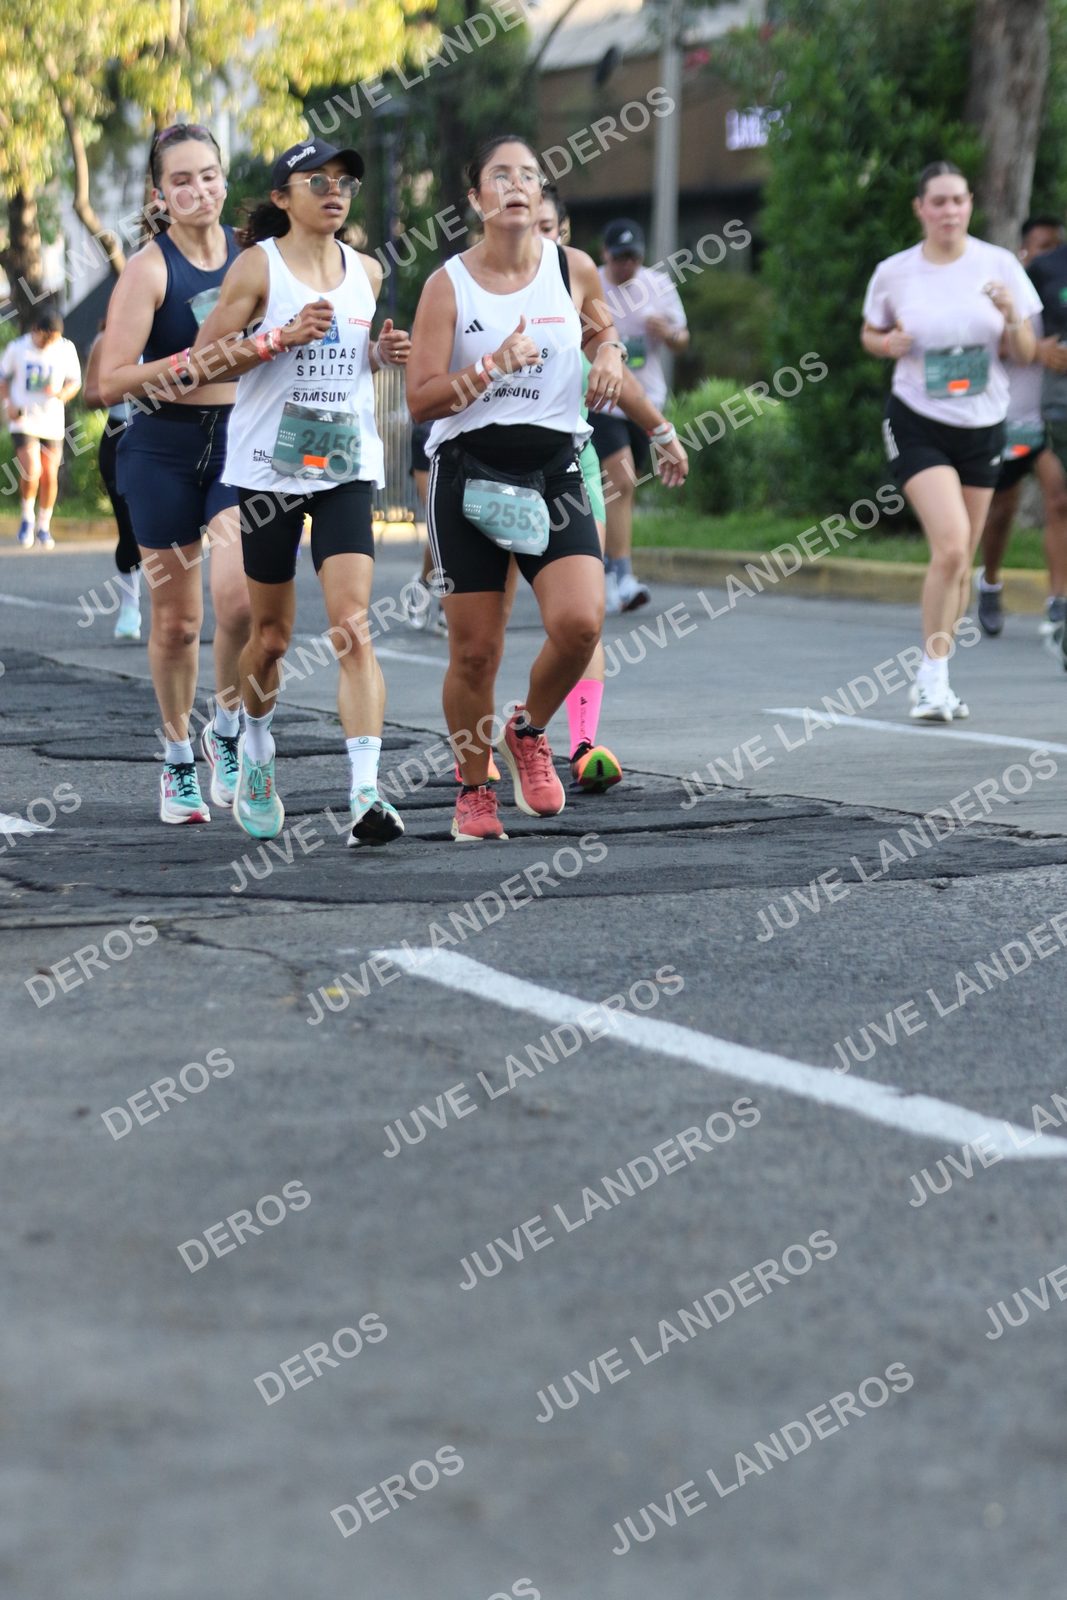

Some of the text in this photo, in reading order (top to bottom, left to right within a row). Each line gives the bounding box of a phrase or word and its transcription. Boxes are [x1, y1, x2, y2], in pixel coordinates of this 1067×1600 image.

[295, 347, 357, 361] ADIDAS
[296, 364, 354, 377] SPLITS
[293, 391, 350, 403] SAMSUN
[483, 386, 540, 403] SMSUNG
